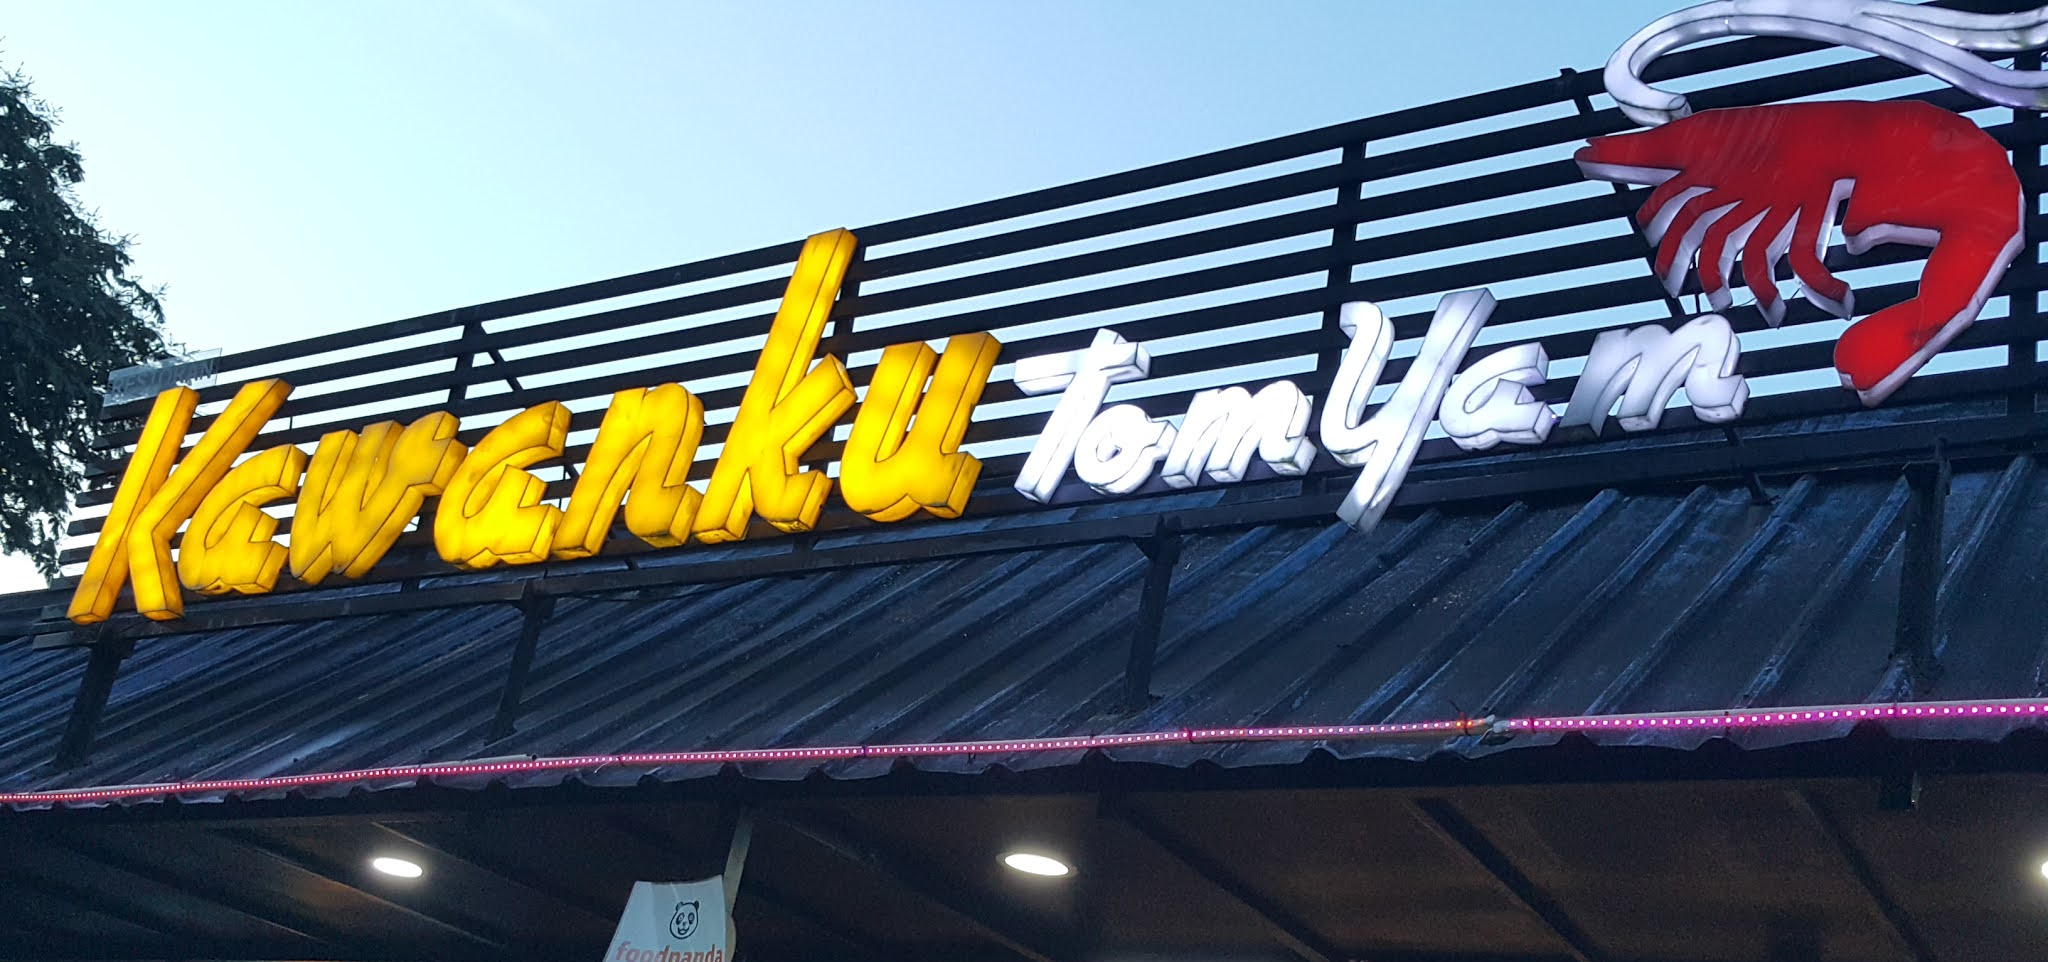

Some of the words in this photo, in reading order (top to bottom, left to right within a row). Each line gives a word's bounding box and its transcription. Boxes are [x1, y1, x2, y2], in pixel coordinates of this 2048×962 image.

[67, 227, 1001, 625] Kawanku
[1014, 328, 1317, 504] Tom
[1320, 287, 1750, 534] Yam
[111, 359, 215, 397] RESTORAN
